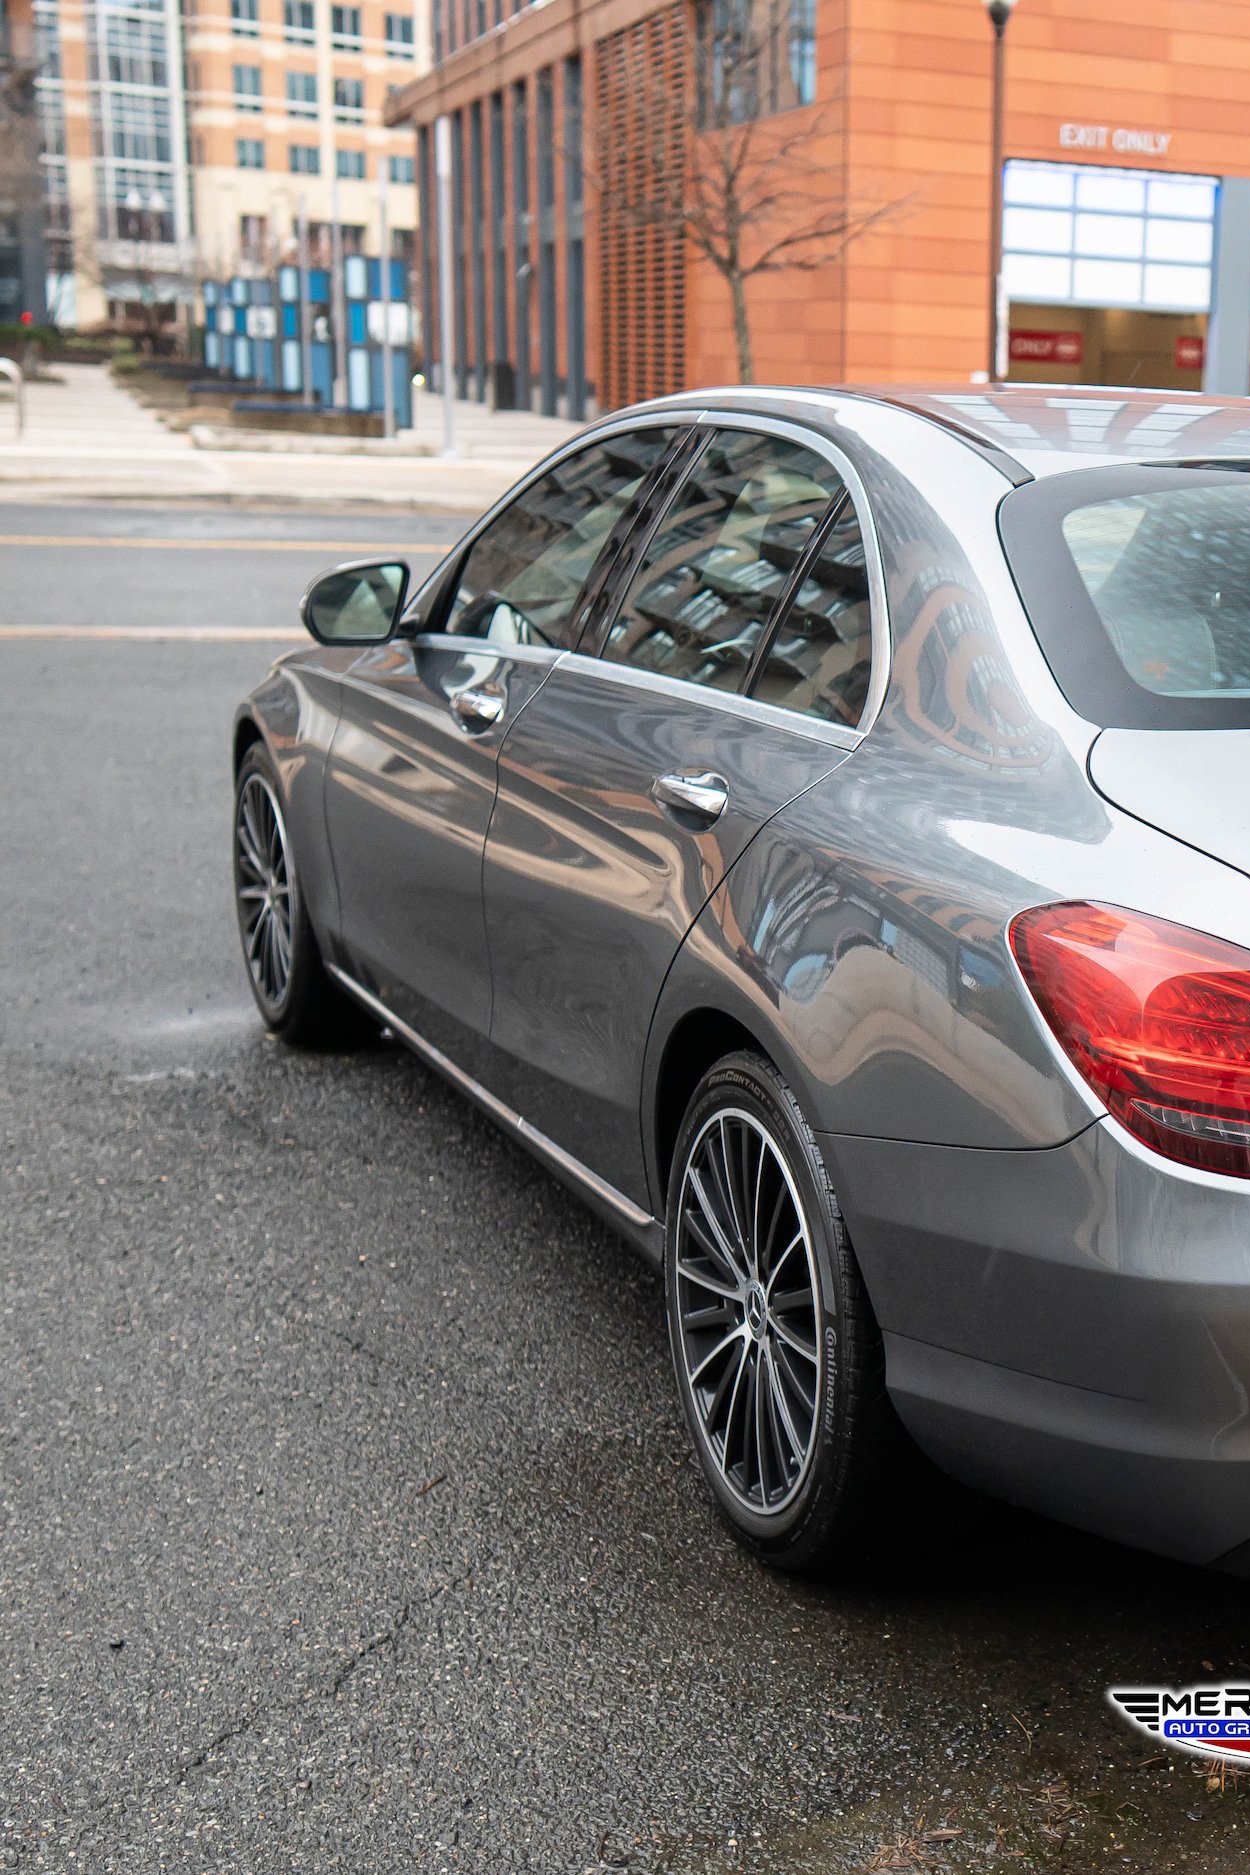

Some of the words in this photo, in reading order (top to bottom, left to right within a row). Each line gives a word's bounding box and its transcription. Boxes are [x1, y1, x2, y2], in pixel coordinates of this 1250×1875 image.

[1059, 123, 1107, 149] EXIT
[1112, 128, 1171, 155] ONLY
[824, 1326, 838, 1434] Continental
